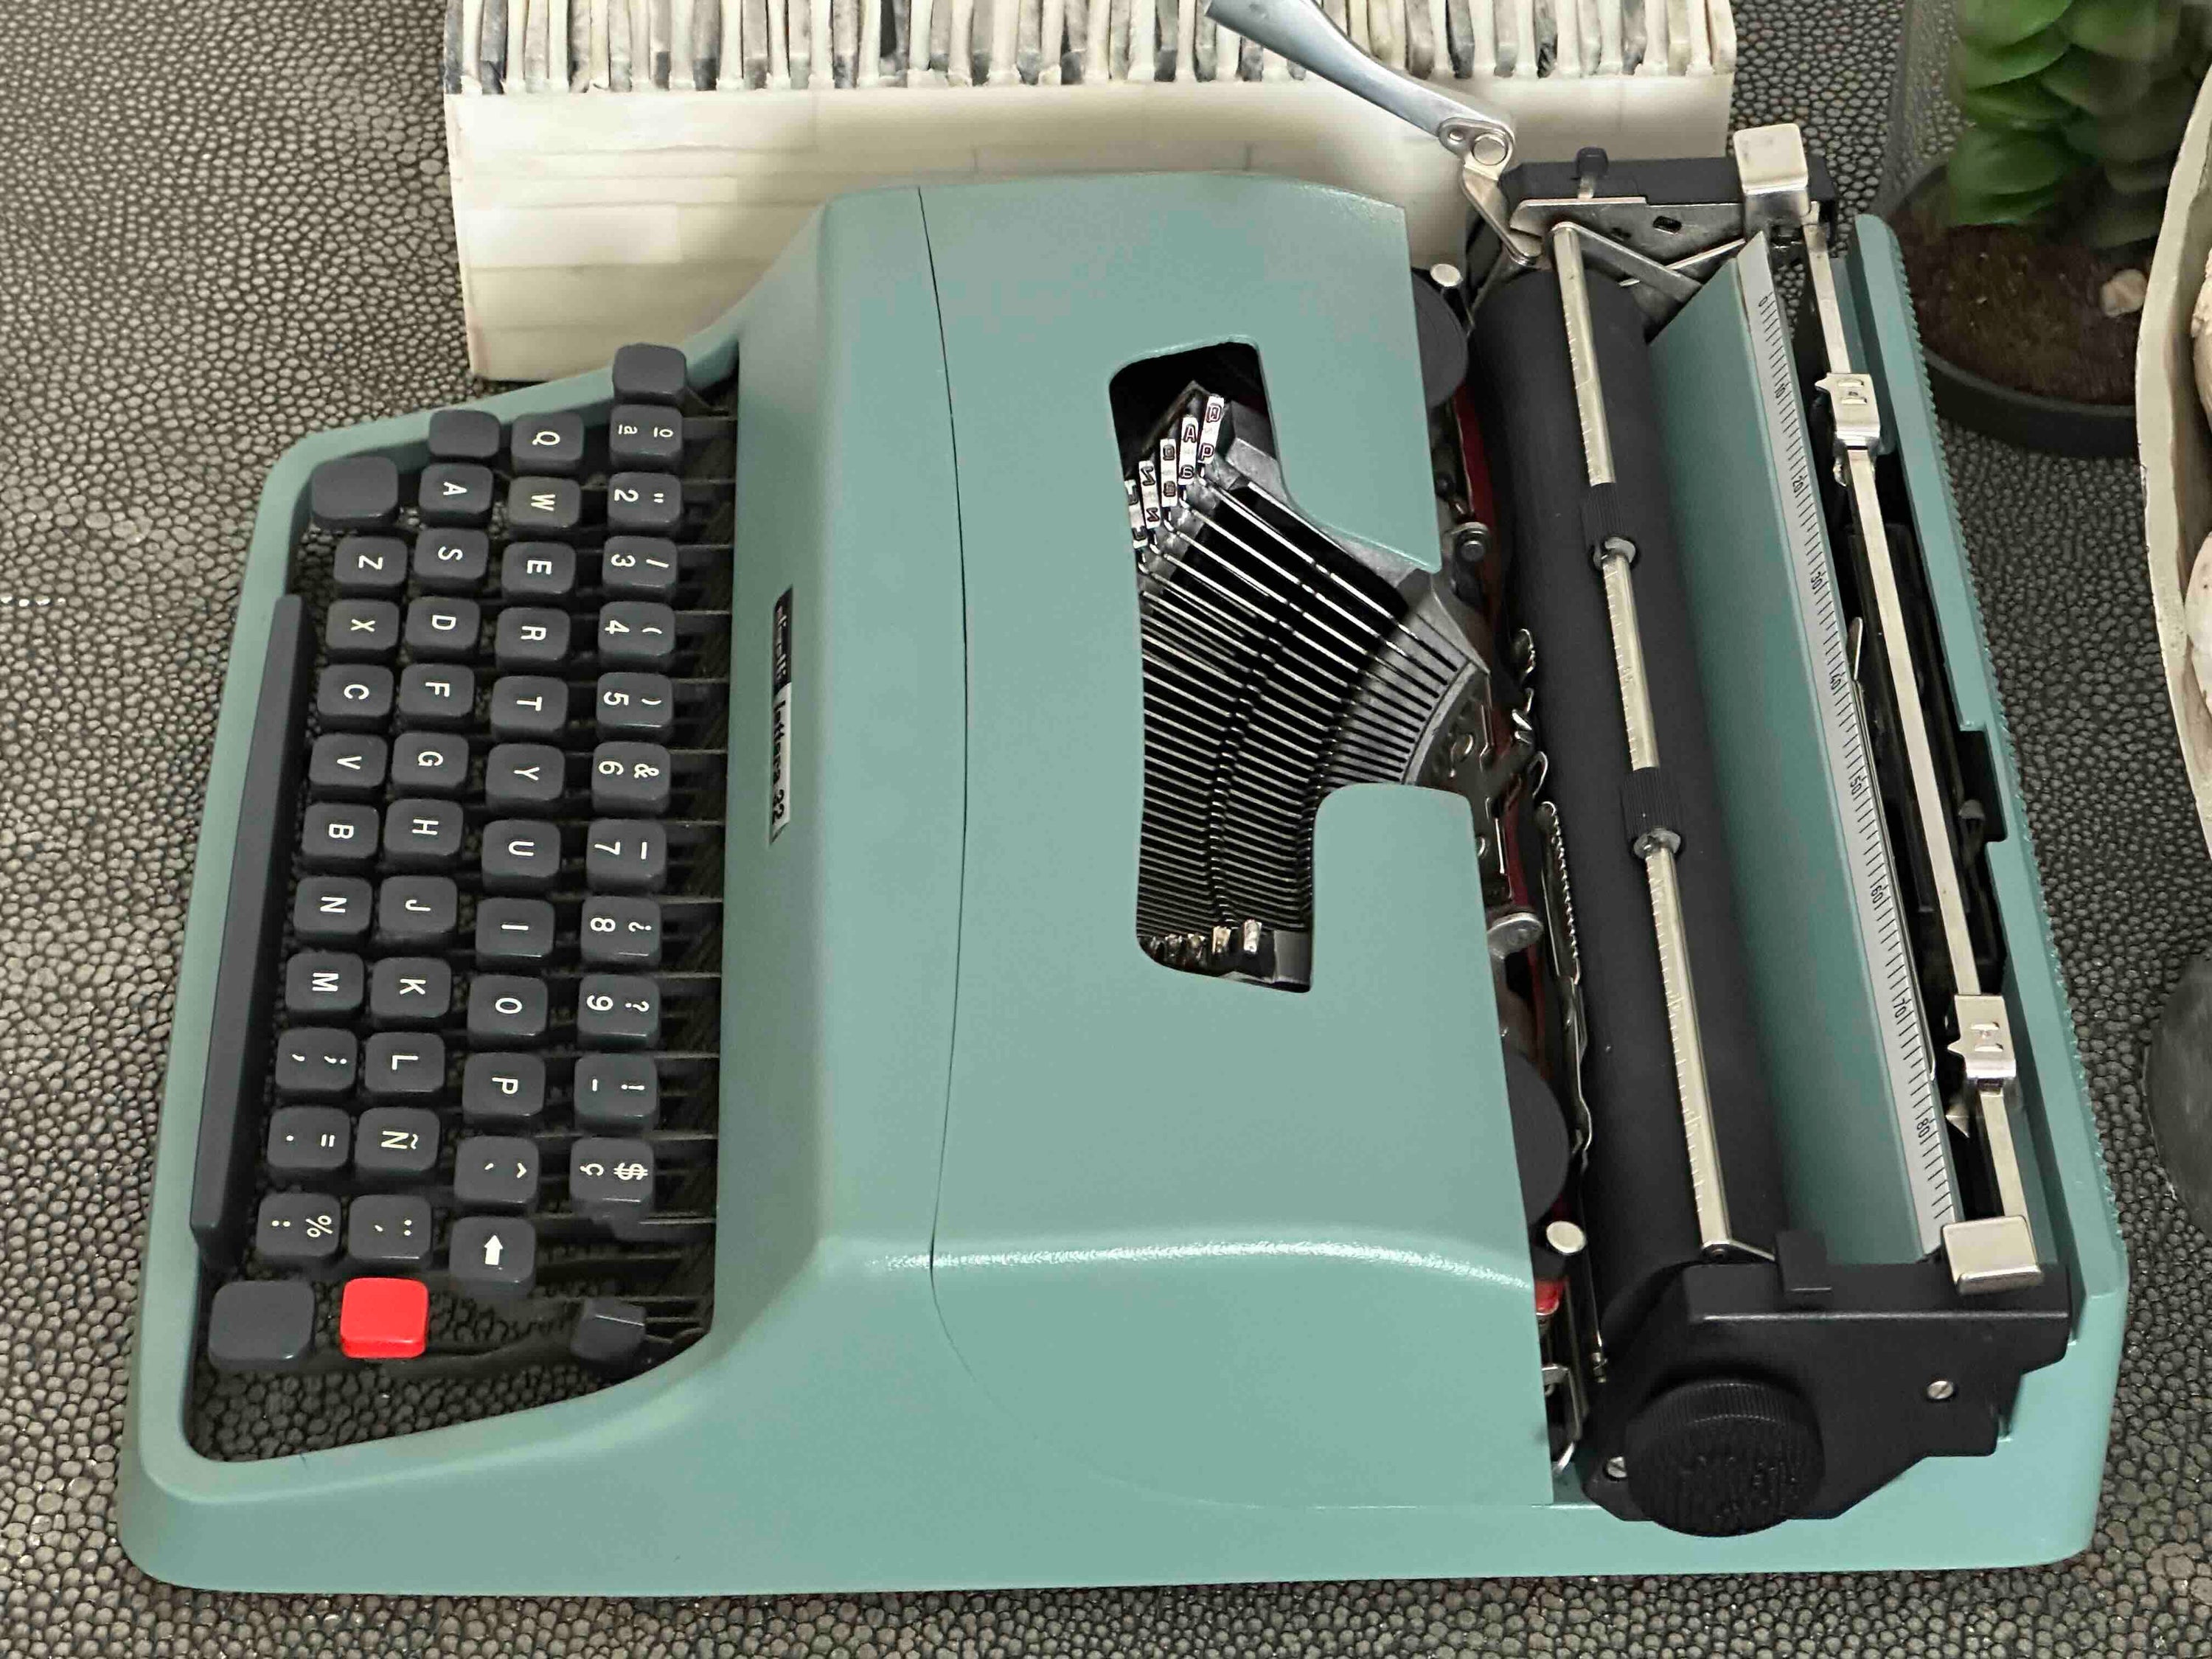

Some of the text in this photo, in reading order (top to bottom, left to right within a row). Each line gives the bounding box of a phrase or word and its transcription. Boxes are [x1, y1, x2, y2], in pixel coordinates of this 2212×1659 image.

[1759, 296, 1767, 307] 0
[1774, 383, 1786, 398] 10
[532, 431, 561, 446] Q
[442, 481, 467, 496] A
[1792, 476, 1804, 493] 20
[530, 493, 556, 512] W
[613, 488, 639, 502] 2
[437, 546, 463, 561] S
[611, 554, 636, 568] 3
[358, 554, 384, 570] Z
[526, 560, 552, 575] E
[645, 558, 669, 568] /
[1811, 571, 1822, 589] 30
[350, 619, 376, 633] X
[431, 614, 457, 630] D
[604, 619, 630, 635] 4
[520, 625, 547, 641] R
[641, 627, 663, 635] (
[425, 681, 451, 698] F
[1830, 674, 1841, 689] 40
[343, 684, 370, 700] C
[603, 691, 630, 706] 5
[516, 696, 543, 712] T
[336, 756, 362, 770] V
[417, 751, 444, 767] G
[513, 766, 540, 781] Y
[598, 760, 625, 776] 6
[633, 763, 660, 779] &
[1850, 776, 1862, 795] 50
[772, 788, 785, 825] 32
[328, 823, 355, 839] B
[411, 818, 439, 835] H
[508, 841, 535, 857] U
[594, 841, 621, 855] 7
[1871, 886, 1883, 903] 60
[319, 896, 347, 914] N
[405, 899, 431, 912] J
[590, 917, 616, 933] 8
[627, 922, 652, 933] ¿
[311, 972, 339, 992] M
[399, 978, 426, 995] K
[495, 997, 523, 1015] O
[586, 995, 613, 1011] 9
[625, 1001, 650, 1012] ?
[1893, 998, 1906, 1018] 70
[324, 1055, 347, 1065] ;
[392, 1054, 419, 1071] L
[492, 1077, 519, 1095] P
[1917, 1118, 1930, 1138] 80
[380, 1131, 420, 1150] Ñ
[580, 1163, 605, 1177] ç
[613, 1162, 648, 1181] $
[305, 1215, 333, 1238] %
